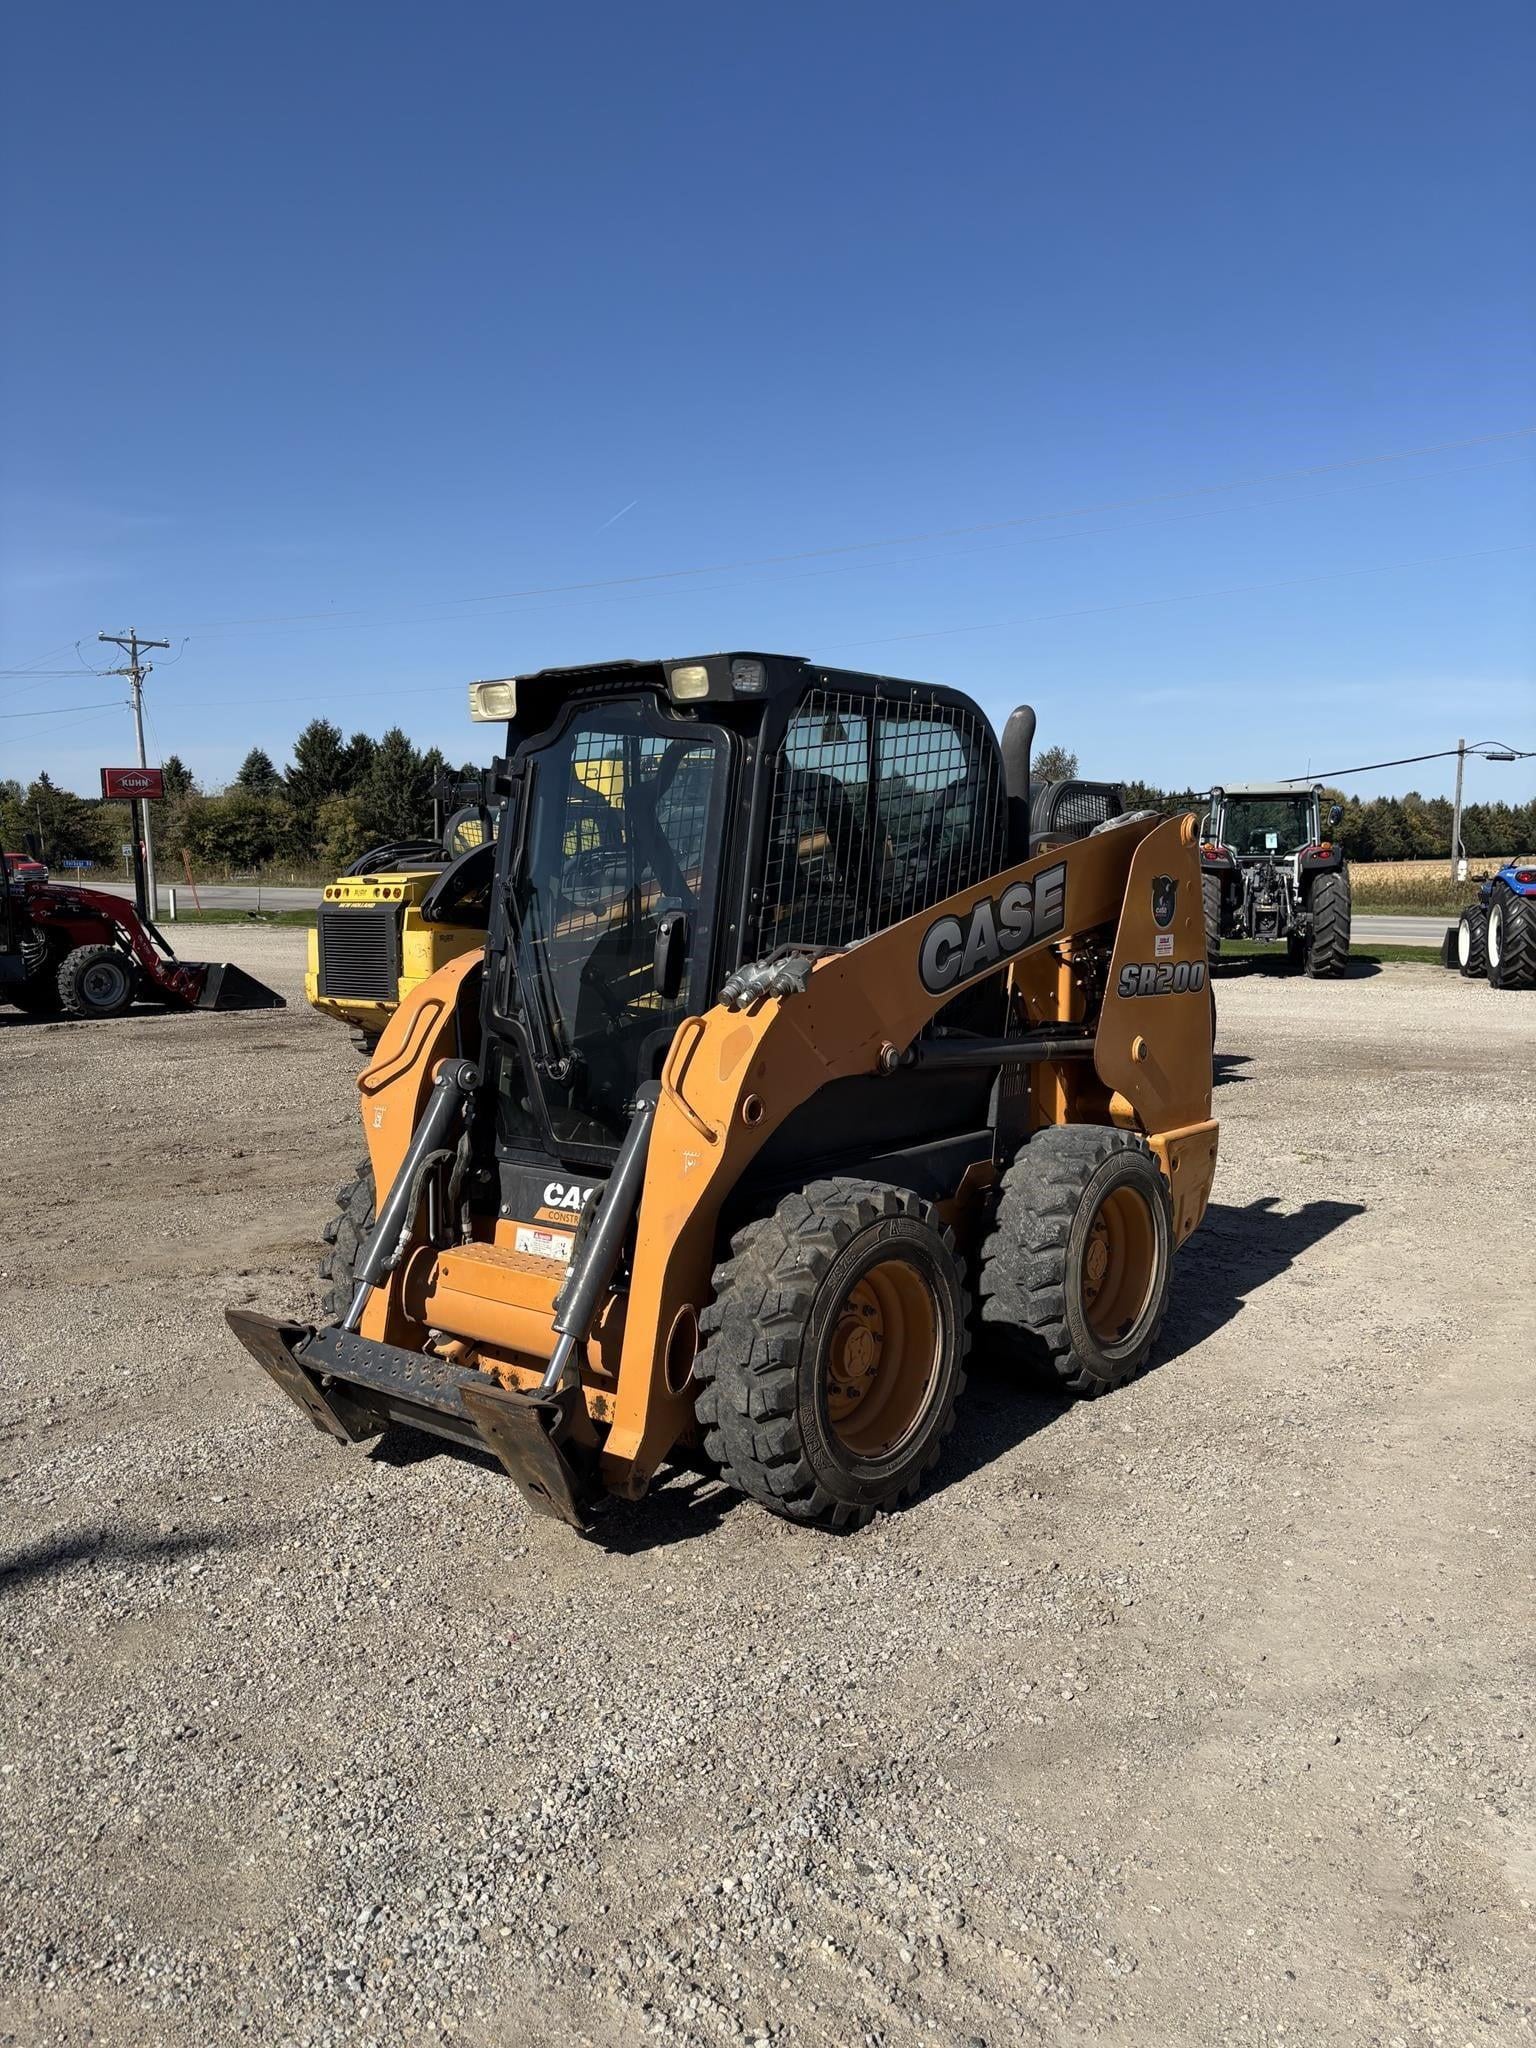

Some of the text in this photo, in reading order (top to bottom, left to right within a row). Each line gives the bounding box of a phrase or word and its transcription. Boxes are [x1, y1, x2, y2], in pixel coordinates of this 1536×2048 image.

[121, 779, 149, 787] KUHN
[921, 863, 1066, 993] CASE
[1118, 961, 1206, 998] SR200
[548, 1210, 579, 1224] CONSTR
